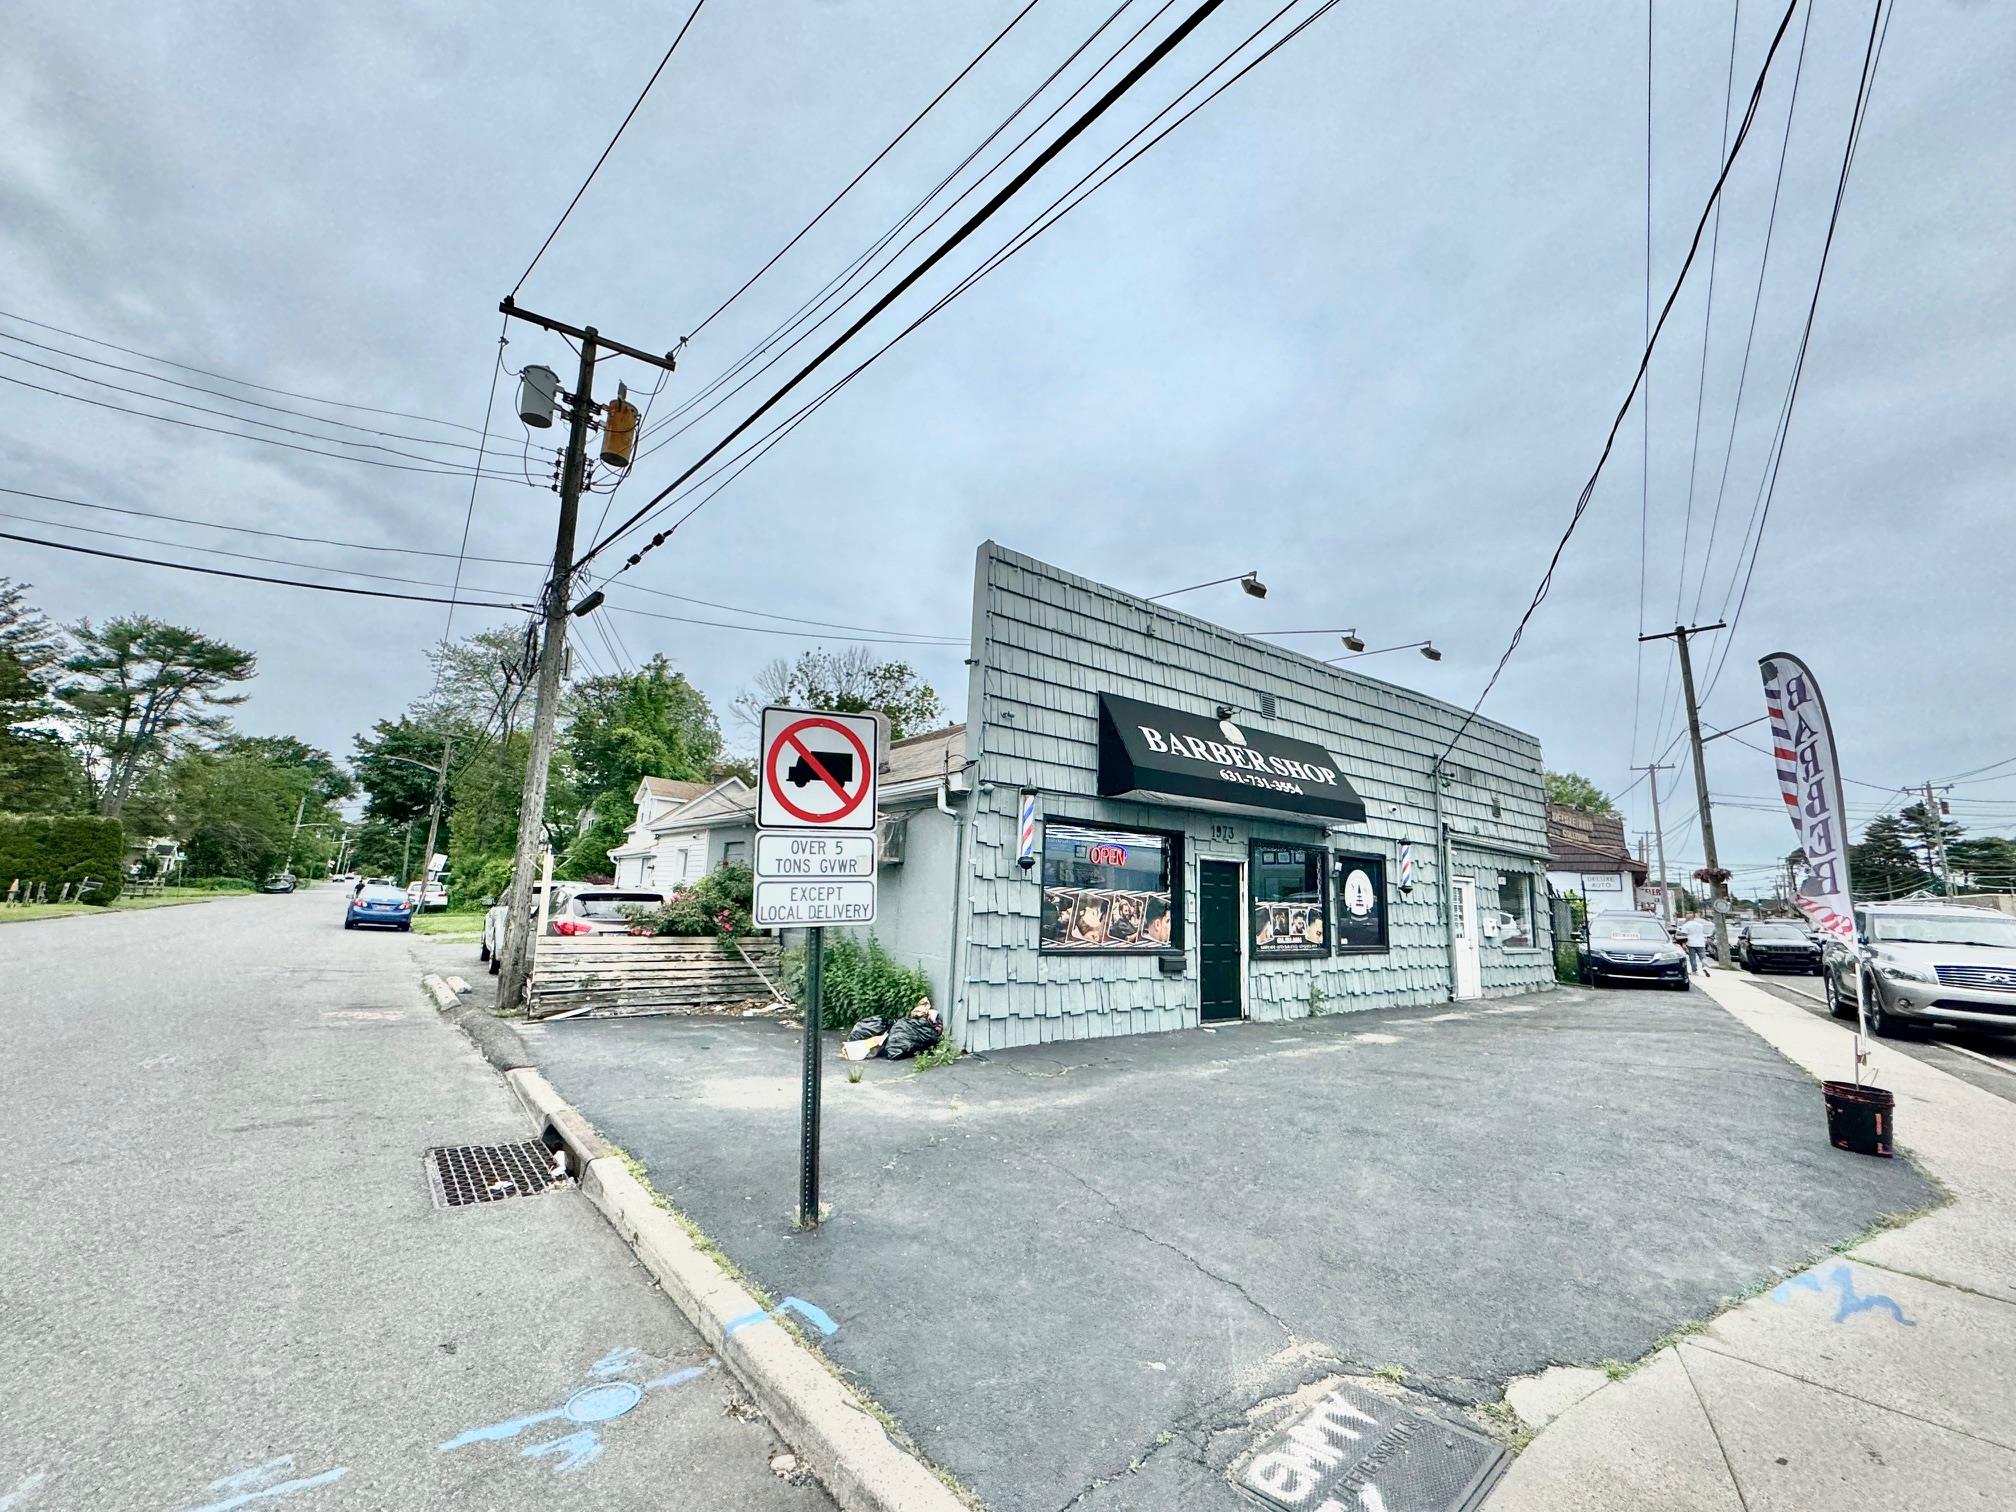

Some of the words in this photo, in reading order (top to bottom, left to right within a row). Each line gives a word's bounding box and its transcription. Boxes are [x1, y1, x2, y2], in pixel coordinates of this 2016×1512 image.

[1138, 725, 1274, 775] BARBER
[1269, 755, 1338, 786] SHOP
[1211, 824, 1234, 840] 1973
[791, 840, 826, 855] OVER
[835, 841, 843, 855] 5
[1090, 846, 1126, 866] OPEN
[776, 858, 811, 874] TONS
[820, 858, 857, 874] GVWR
[791, 886, 843, 902] EXCEPT
[760, 905, 804, 921] LOCAL
[808, 903, 870, 920] DELIVERY
